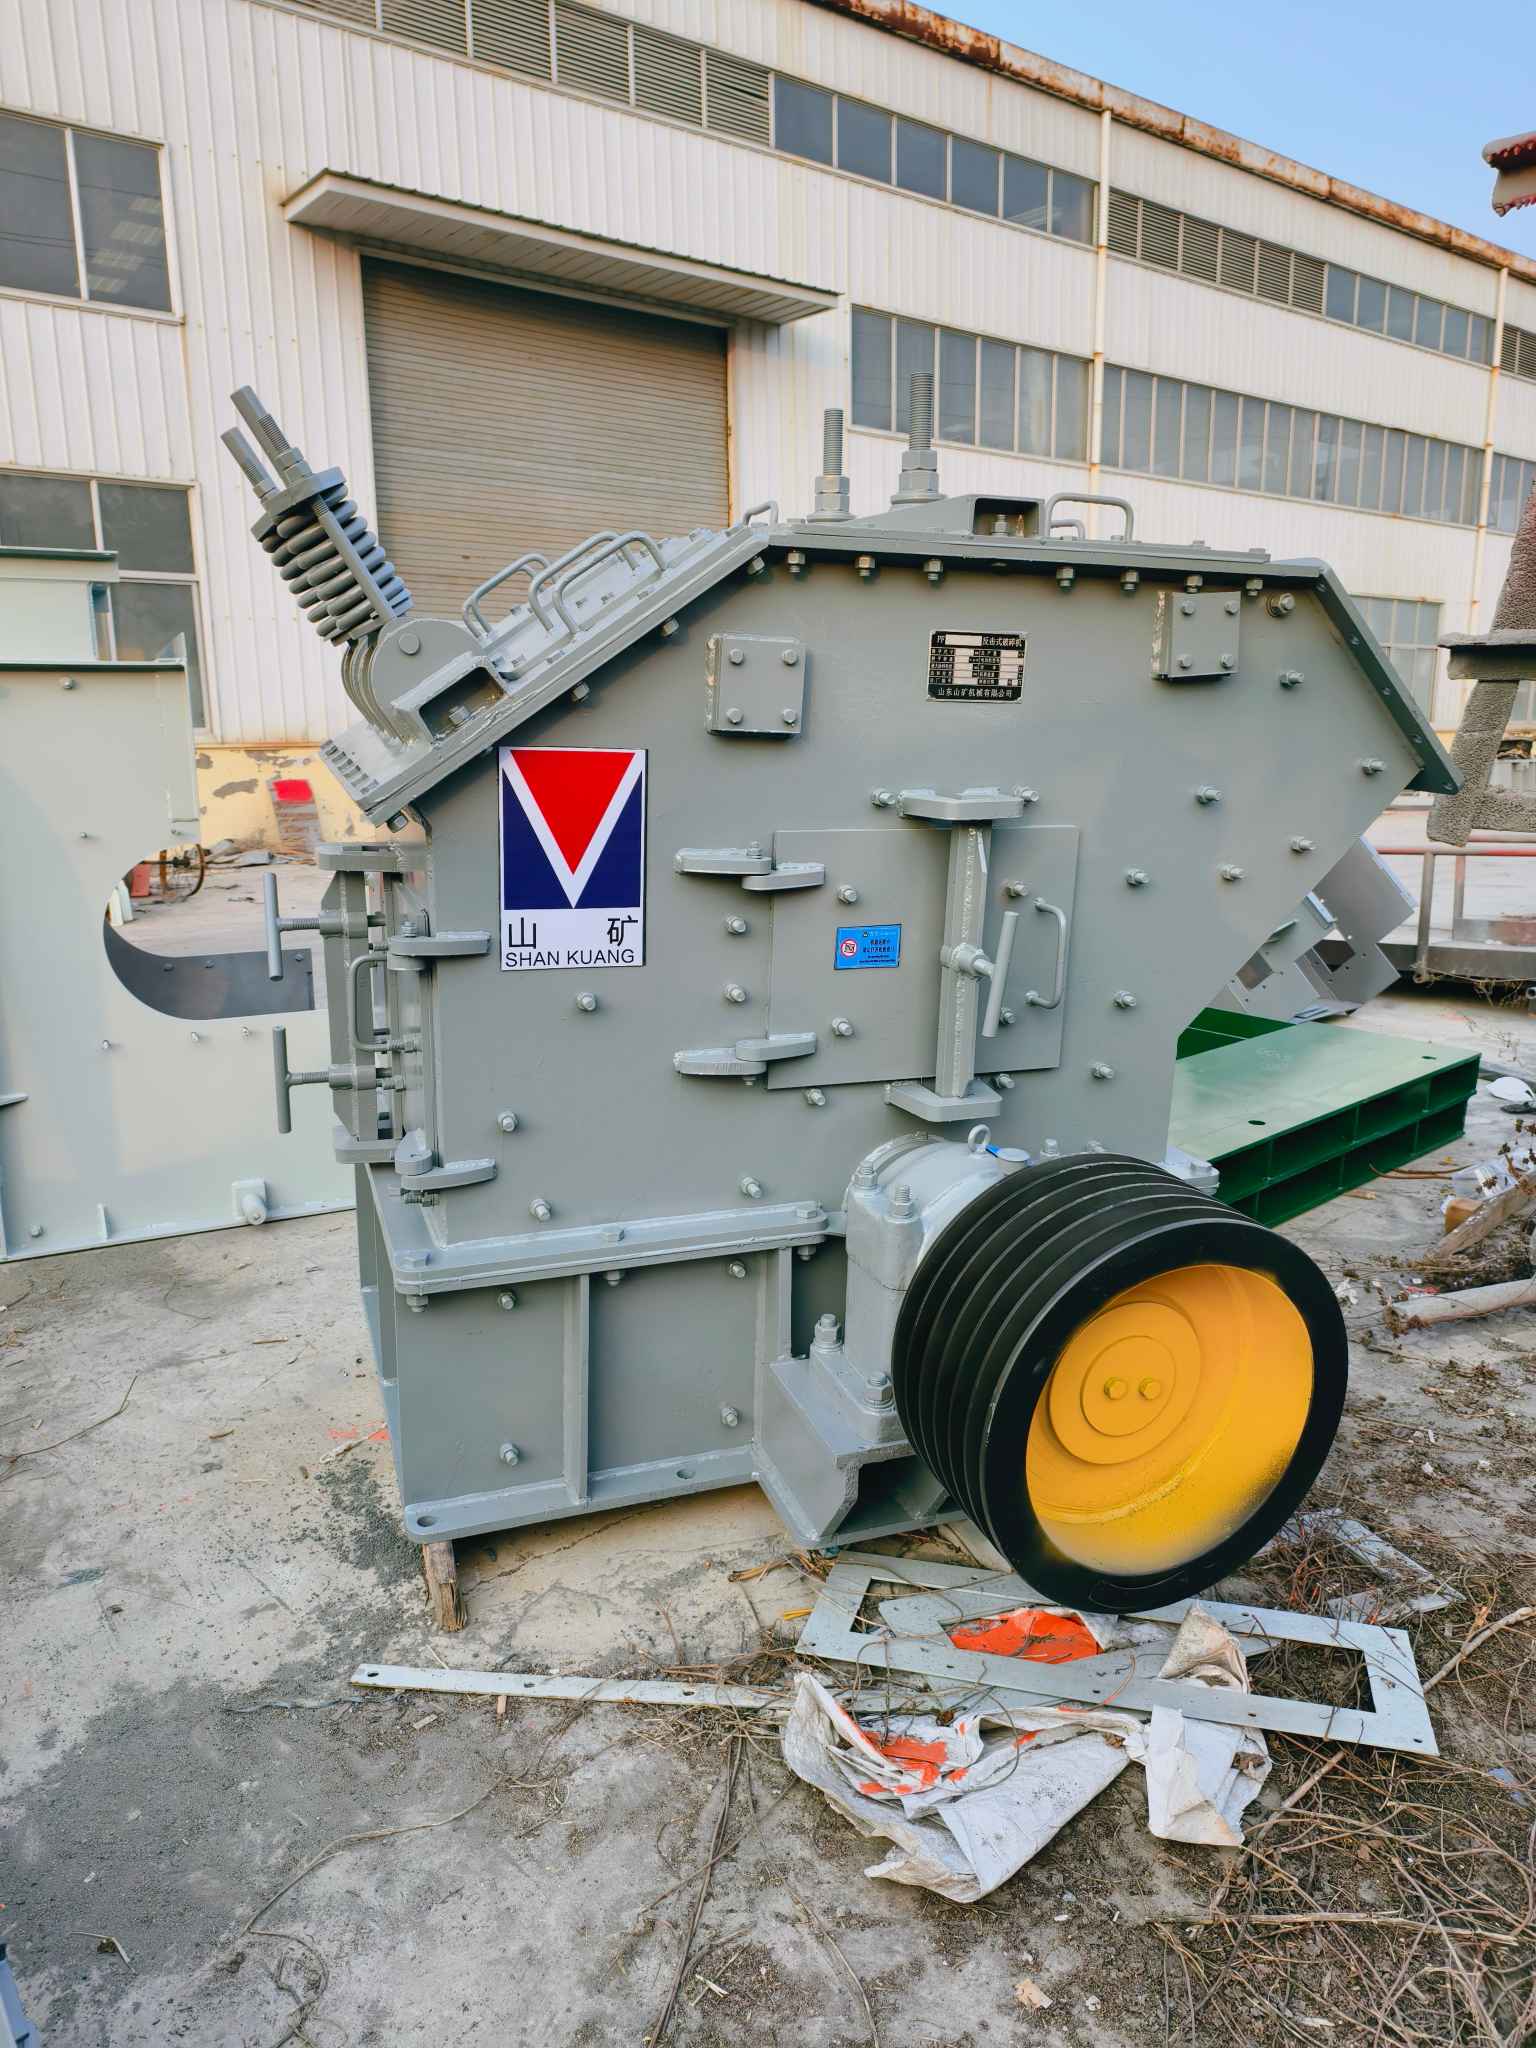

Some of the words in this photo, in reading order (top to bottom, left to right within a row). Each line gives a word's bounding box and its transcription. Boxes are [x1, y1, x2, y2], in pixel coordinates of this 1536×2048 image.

[938, 687, 1013, 698] 山东山矿机械有限公司
[508, 917, 537, 949] 山
[607, 915, 639, 946] 矿
[506, 951, 559, 967] SHAN
[567, 949, 634, 964] KUANG
